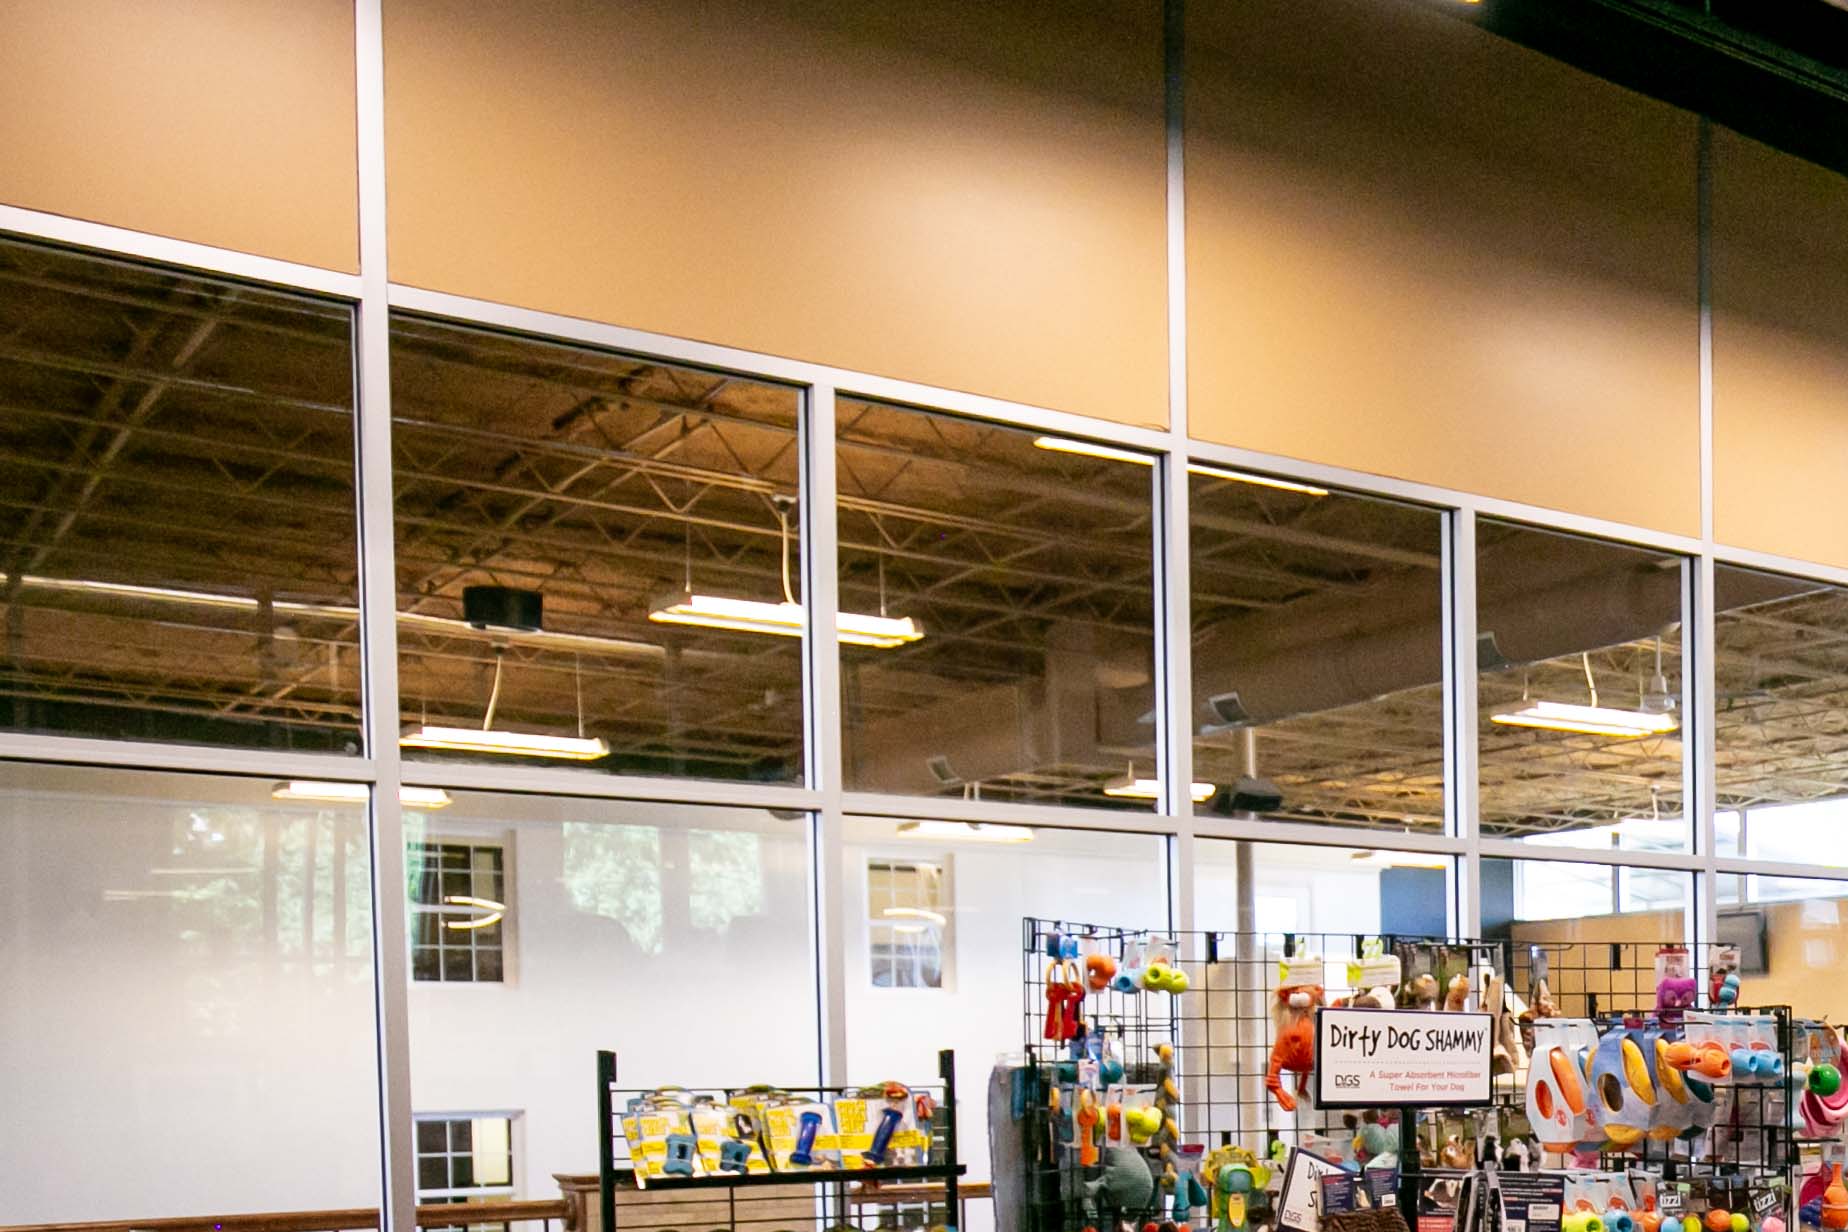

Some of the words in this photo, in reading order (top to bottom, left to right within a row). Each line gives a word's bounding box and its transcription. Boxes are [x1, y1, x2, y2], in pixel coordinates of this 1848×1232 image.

[1330, 1024, 1381, 1057] Dirty
[1425, 1029, 1484, 1054] SHAMMY
[1369, 1070, 1376, 1079] A
[1379, 1070, 1403, 1080] Super
[1405, 1070, 1444, 1079] Absorbent
[1390, 1082, 1414, 1092] Towel
[1416, 1082, 1429, 1092] For
[1431, 1083, 1449, 1092] Your
[1450, 1083, 1465, 1092] Dog
